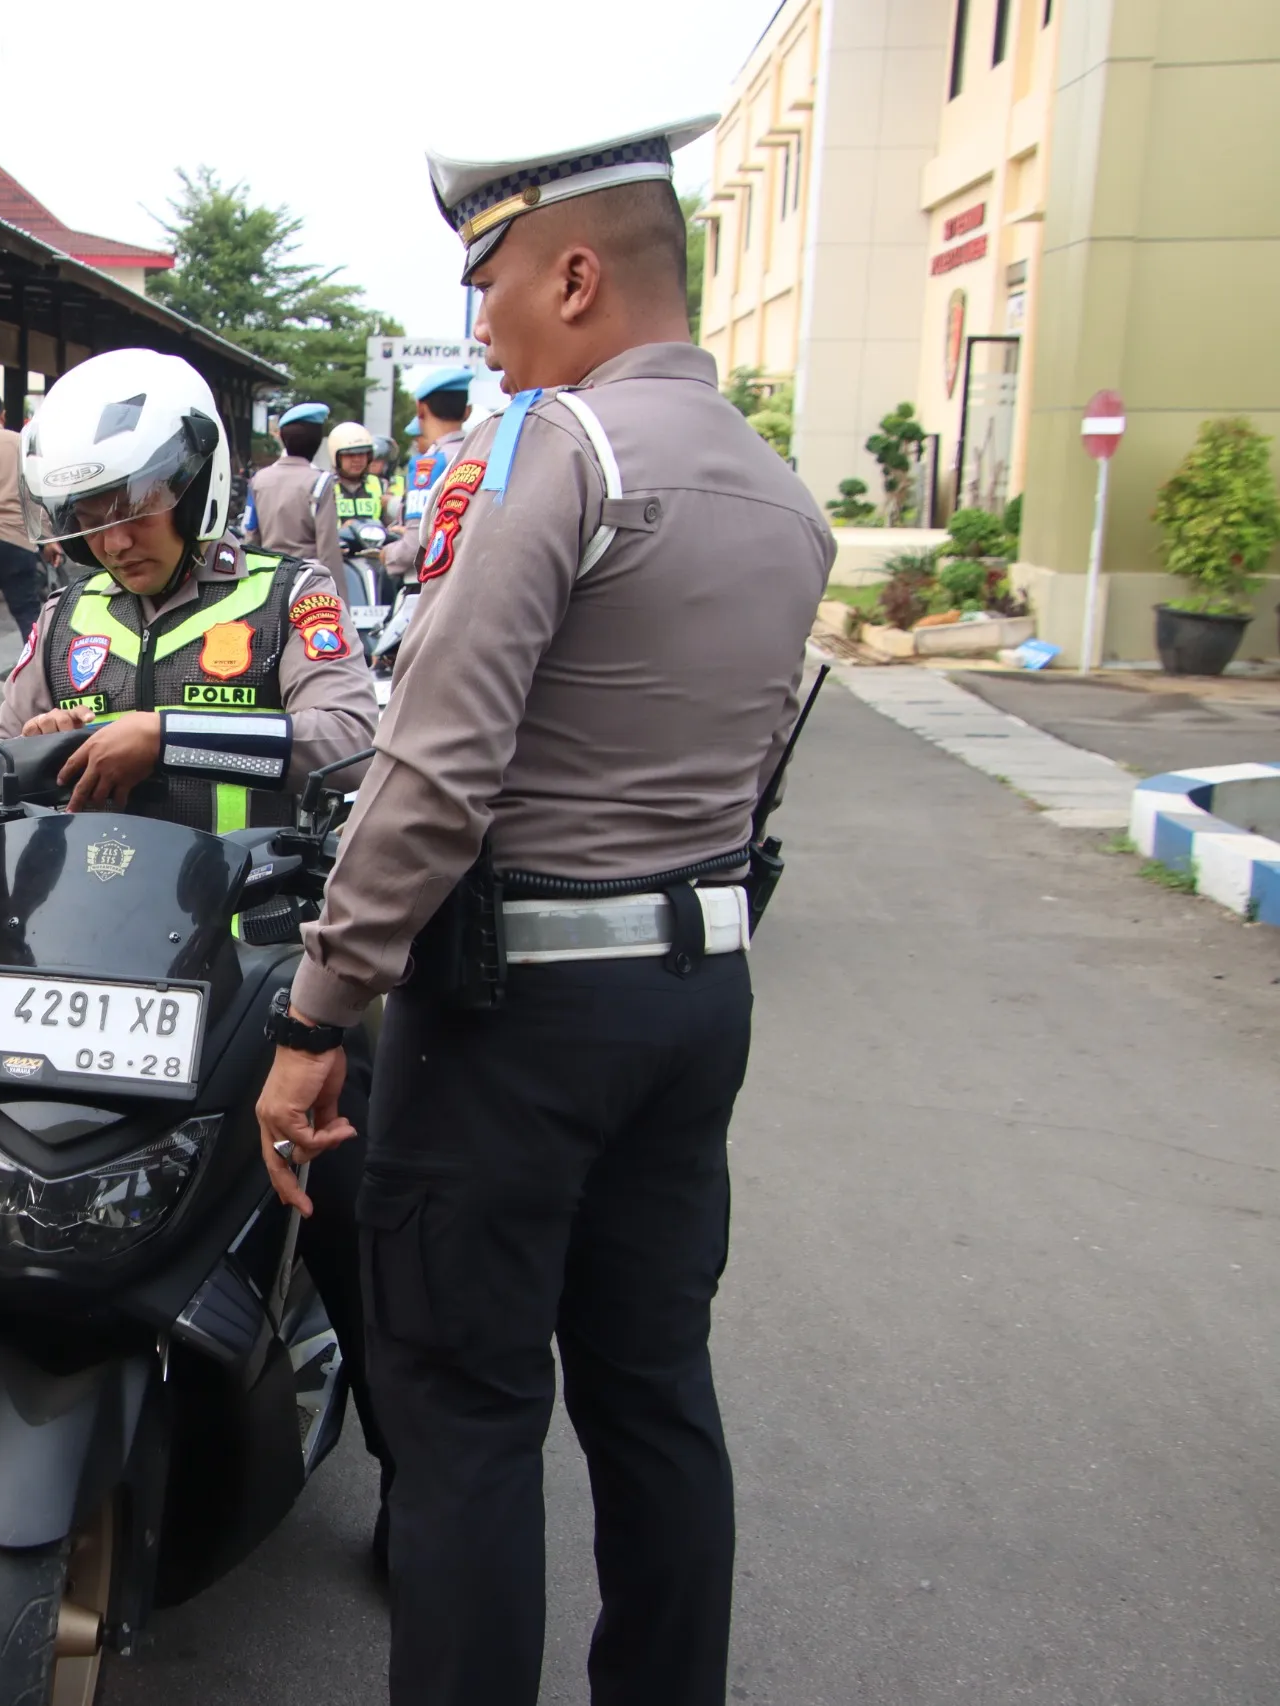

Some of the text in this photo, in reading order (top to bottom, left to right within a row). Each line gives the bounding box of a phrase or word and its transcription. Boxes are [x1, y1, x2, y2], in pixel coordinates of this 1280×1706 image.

[403, 345, 461, 357] KANTOR
[188, 686, 252, 704] POLRI
[14, 986, 110, 1032] 4291
[129, 996, 180, 1036] XB
